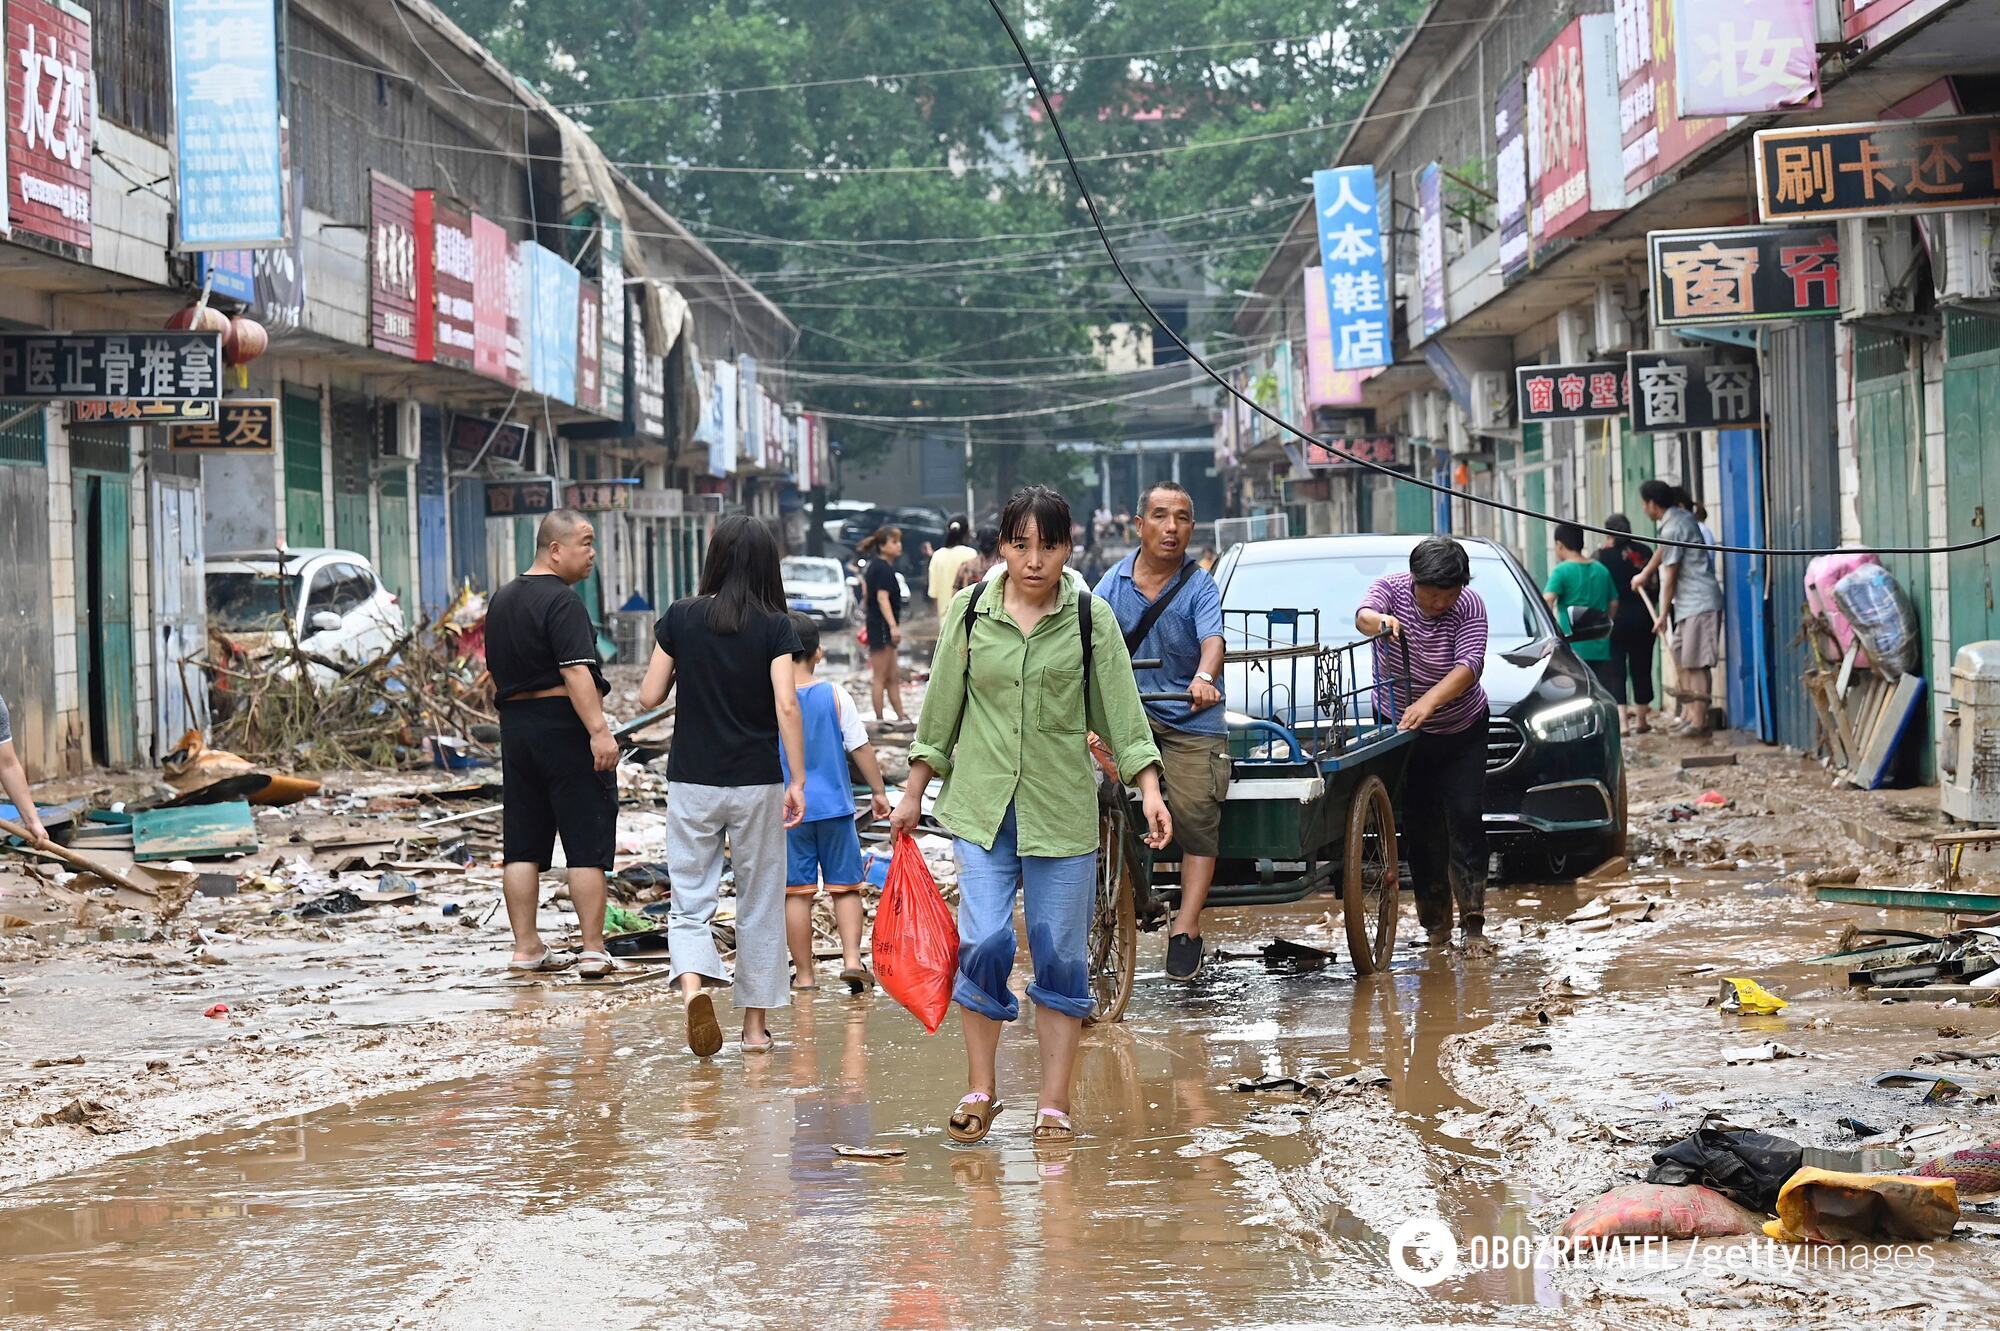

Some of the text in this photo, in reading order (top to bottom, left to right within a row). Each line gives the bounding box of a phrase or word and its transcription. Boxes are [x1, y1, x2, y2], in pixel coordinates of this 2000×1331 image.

[183, 0, 268, 107] 推拿
[1696, 20, 1806, 98] 妆
[1322, 176, 1386, 362] 人本鞋店
[1525, 371, 1629, 413] 窗帘壁
[1638, 361, 1752, 426] 窗帘
